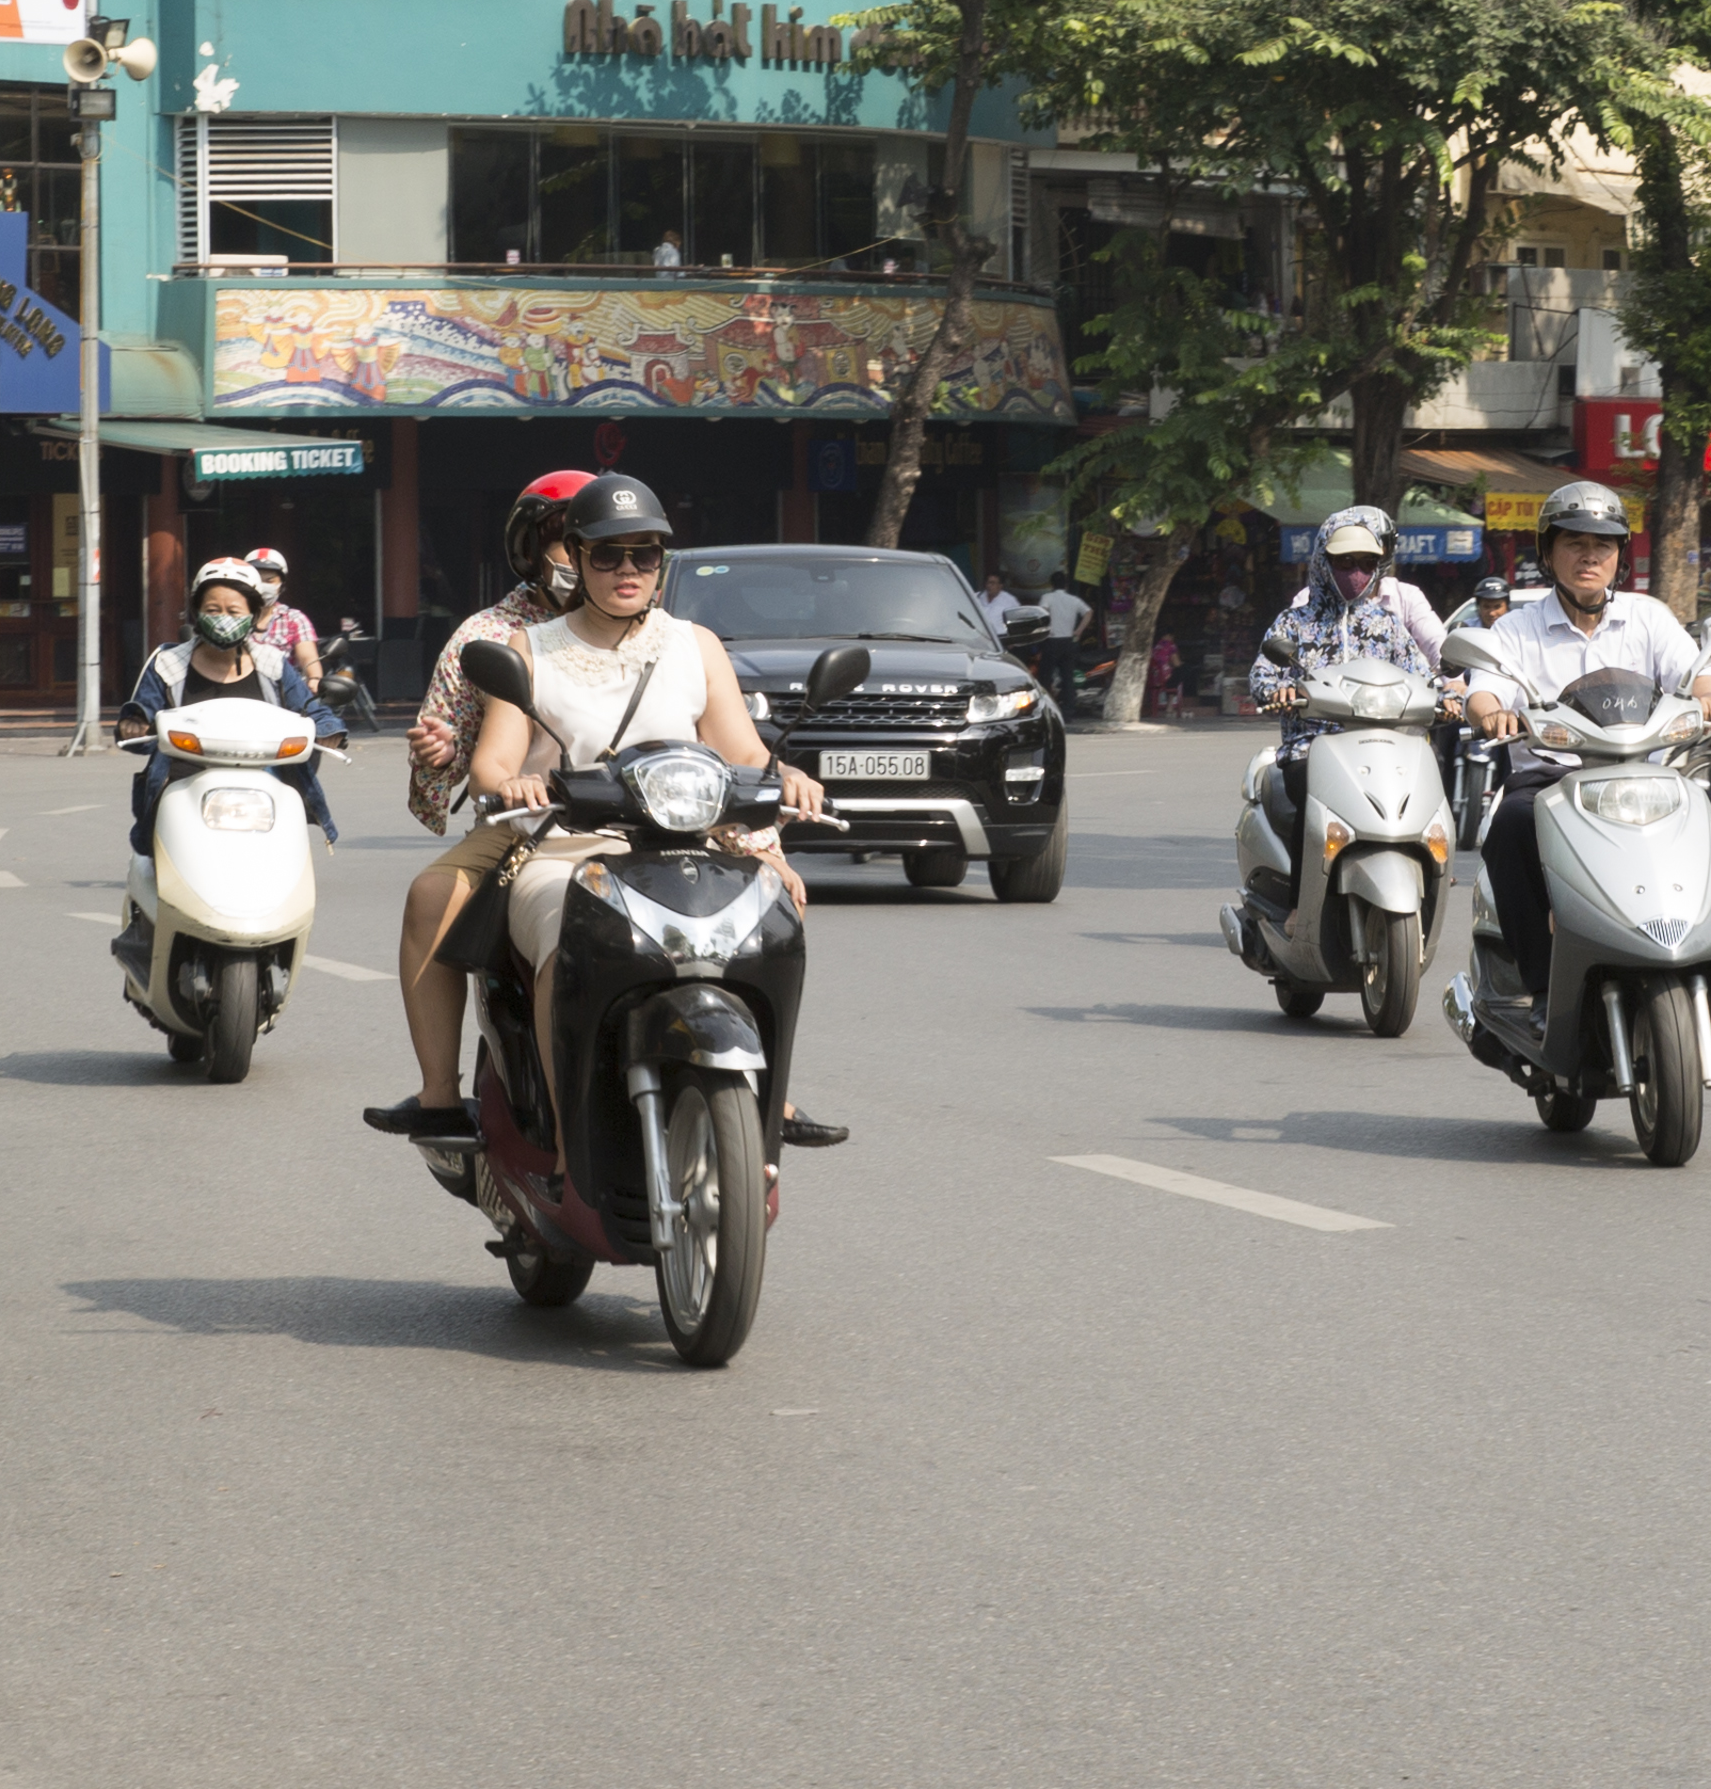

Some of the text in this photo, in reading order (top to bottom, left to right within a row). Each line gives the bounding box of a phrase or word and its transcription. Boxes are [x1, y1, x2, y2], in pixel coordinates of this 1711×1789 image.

[761, 3, 843, 64] kim
[14, 296, 67, 360] LONG
[201, 448, 356, 475] BOOKING TICKET
[882, 684, 959, 694] ROVER
[826, 755, 926, 776] 15A-055.08
[660, 849, 710, 858] HONDA
